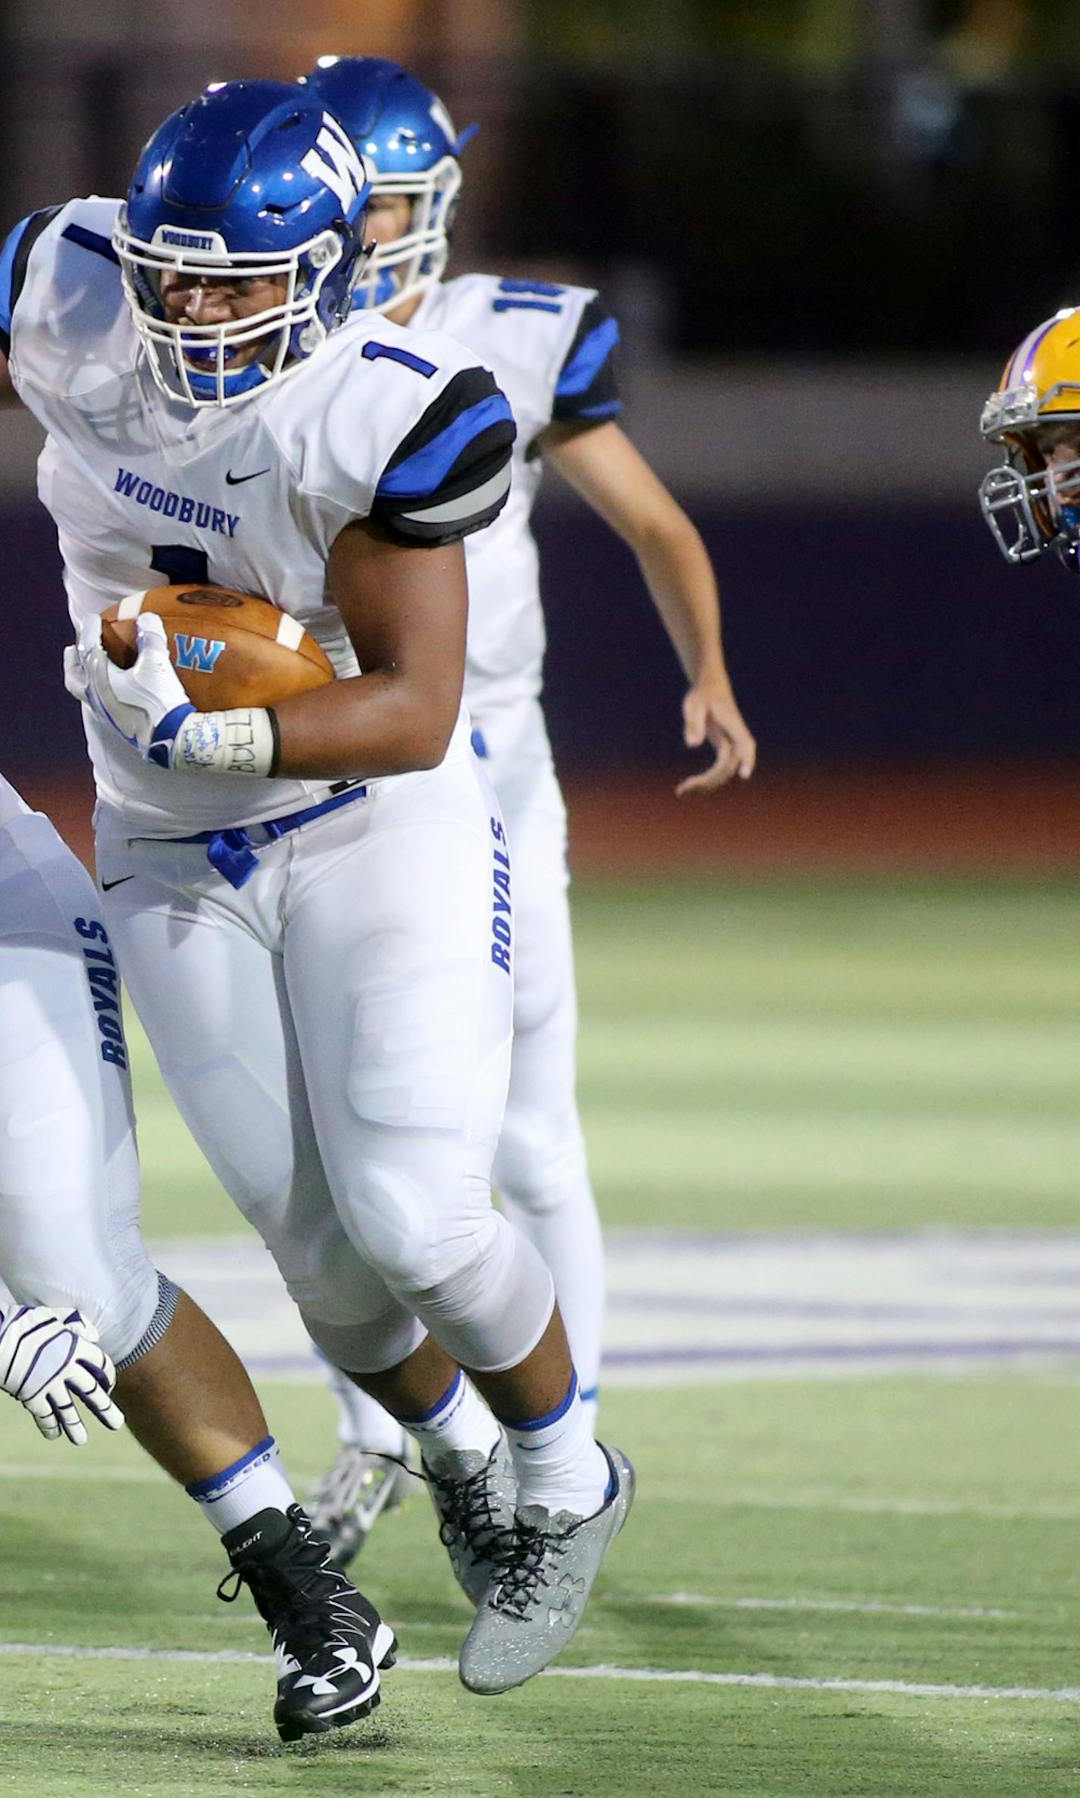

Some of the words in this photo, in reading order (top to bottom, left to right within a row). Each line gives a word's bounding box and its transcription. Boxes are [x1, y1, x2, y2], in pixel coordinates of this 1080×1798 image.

[299, 111, 367, 215] W
[162, 230, 214, 250] WOODBURY
[361, 339, 438, 379] 1
[114, 467, 240, 538] WOODBURY
[174, 633, 226, 674] W
[225, 711, 256, 774] BULL
[490, 816, 512, 977] ROYALS
[73, 917, 127, 1071] ROYALS
